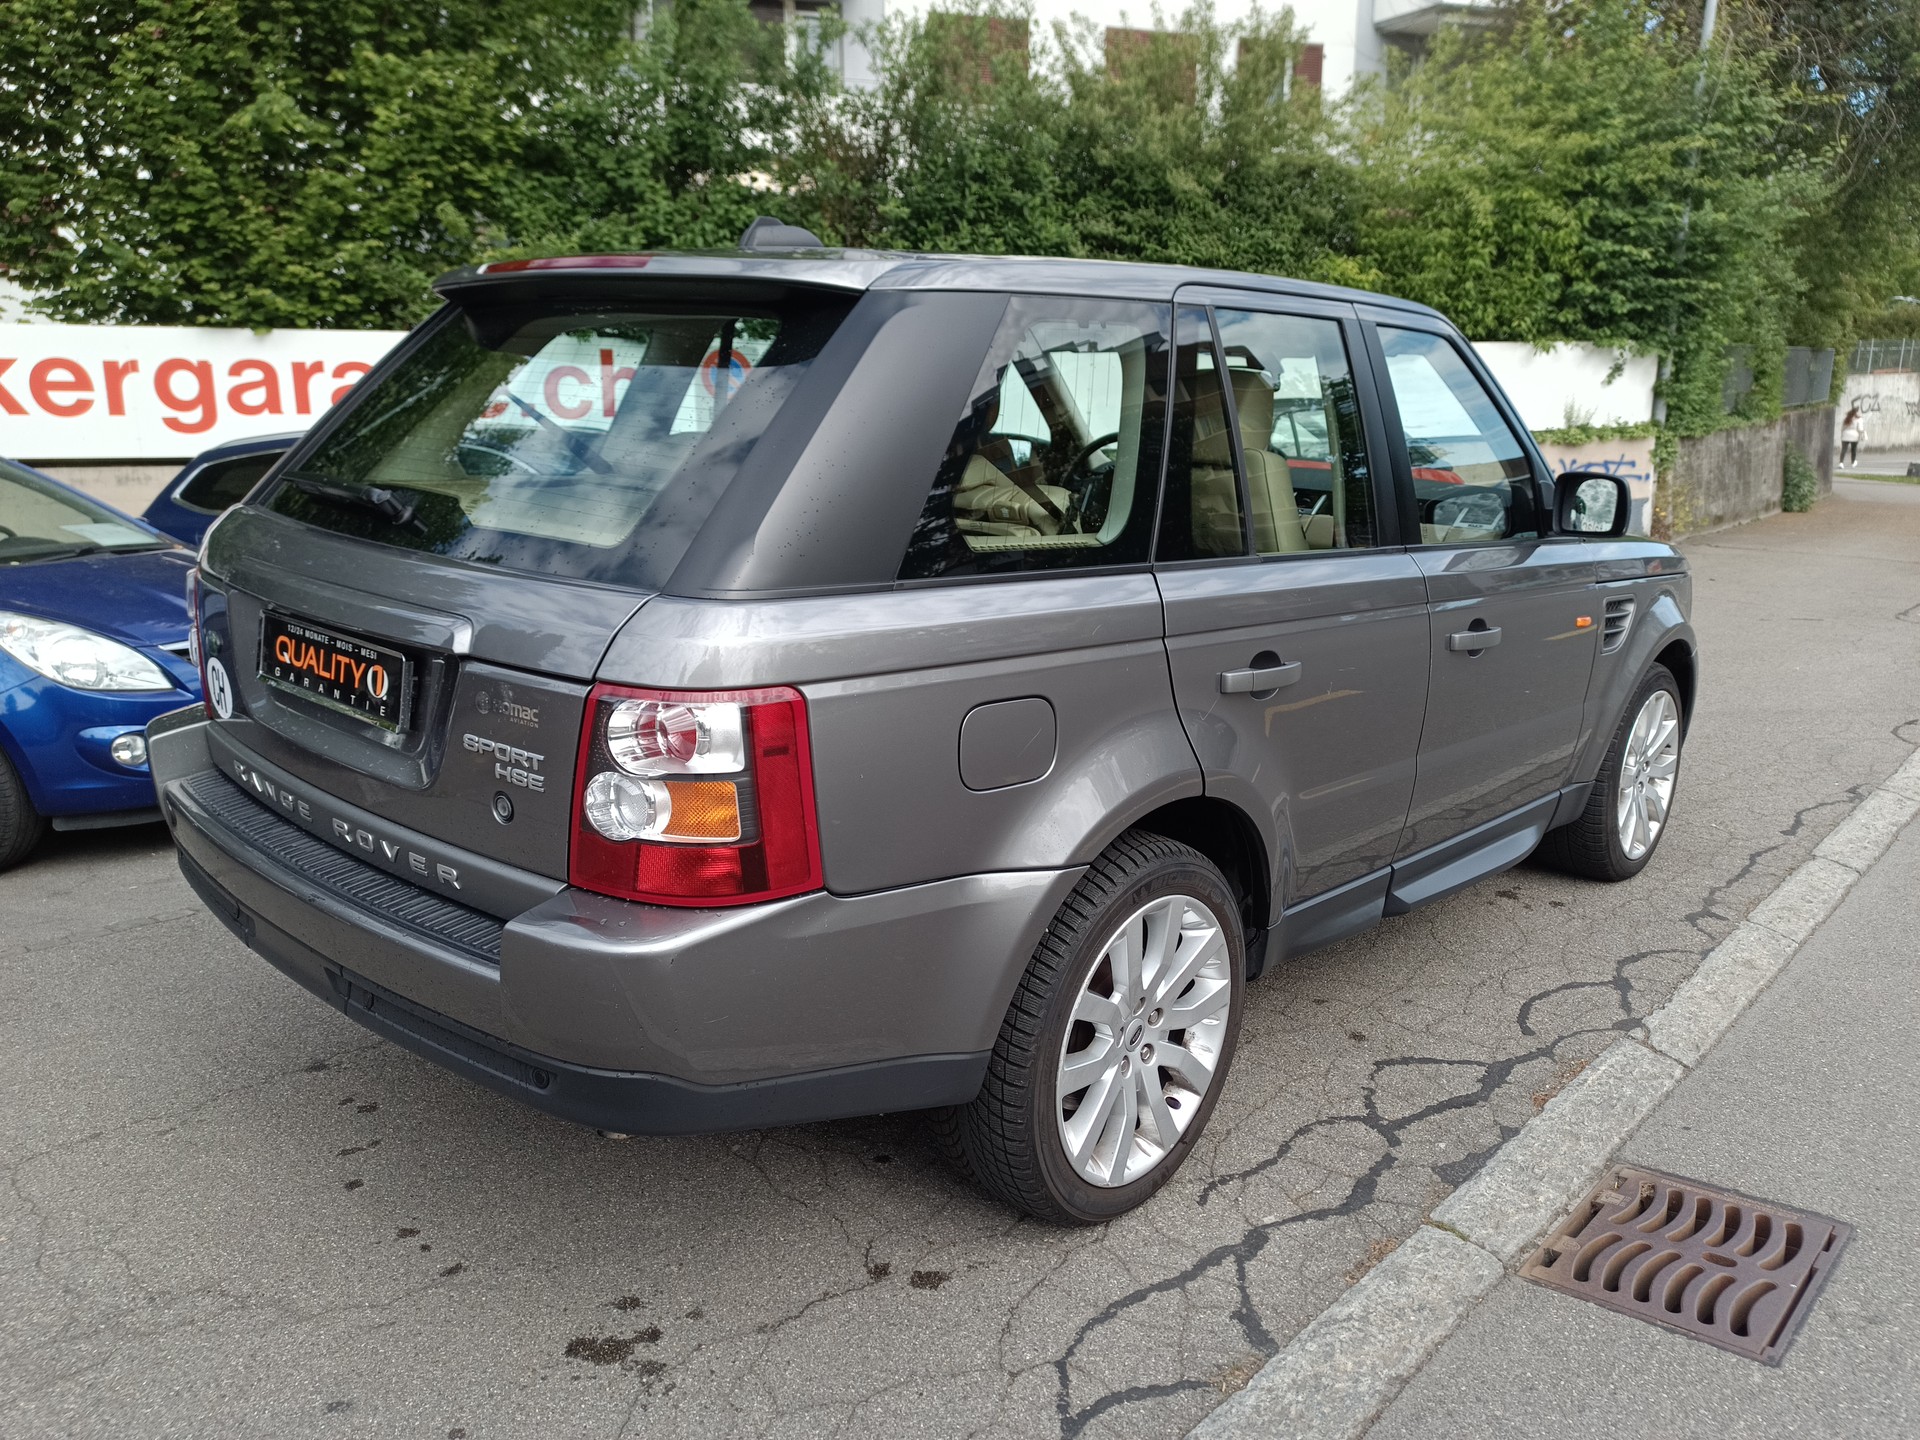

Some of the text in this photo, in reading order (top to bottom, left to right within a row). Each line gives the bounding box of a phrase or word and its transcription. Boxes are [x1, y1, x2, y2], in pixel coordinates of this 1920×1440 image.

[276, 635, 366, 689] QUALITY
[288, 624, 304, 635] 12/24
[304, 630, 329, 645] MONATE
[336, 640, 353, 652] MOIS
[360, 647, 378, 660] MESI
[212, 665, 228, 714] CH
[274, 667, 386, 717] GARANTIE
[510, 717, 539, 729] AVIATION
[463, 733, 545, 771] SPORT
[495, 762, 545, 793] HSE
[233, 760, 461, 890] RANGE ROVER
